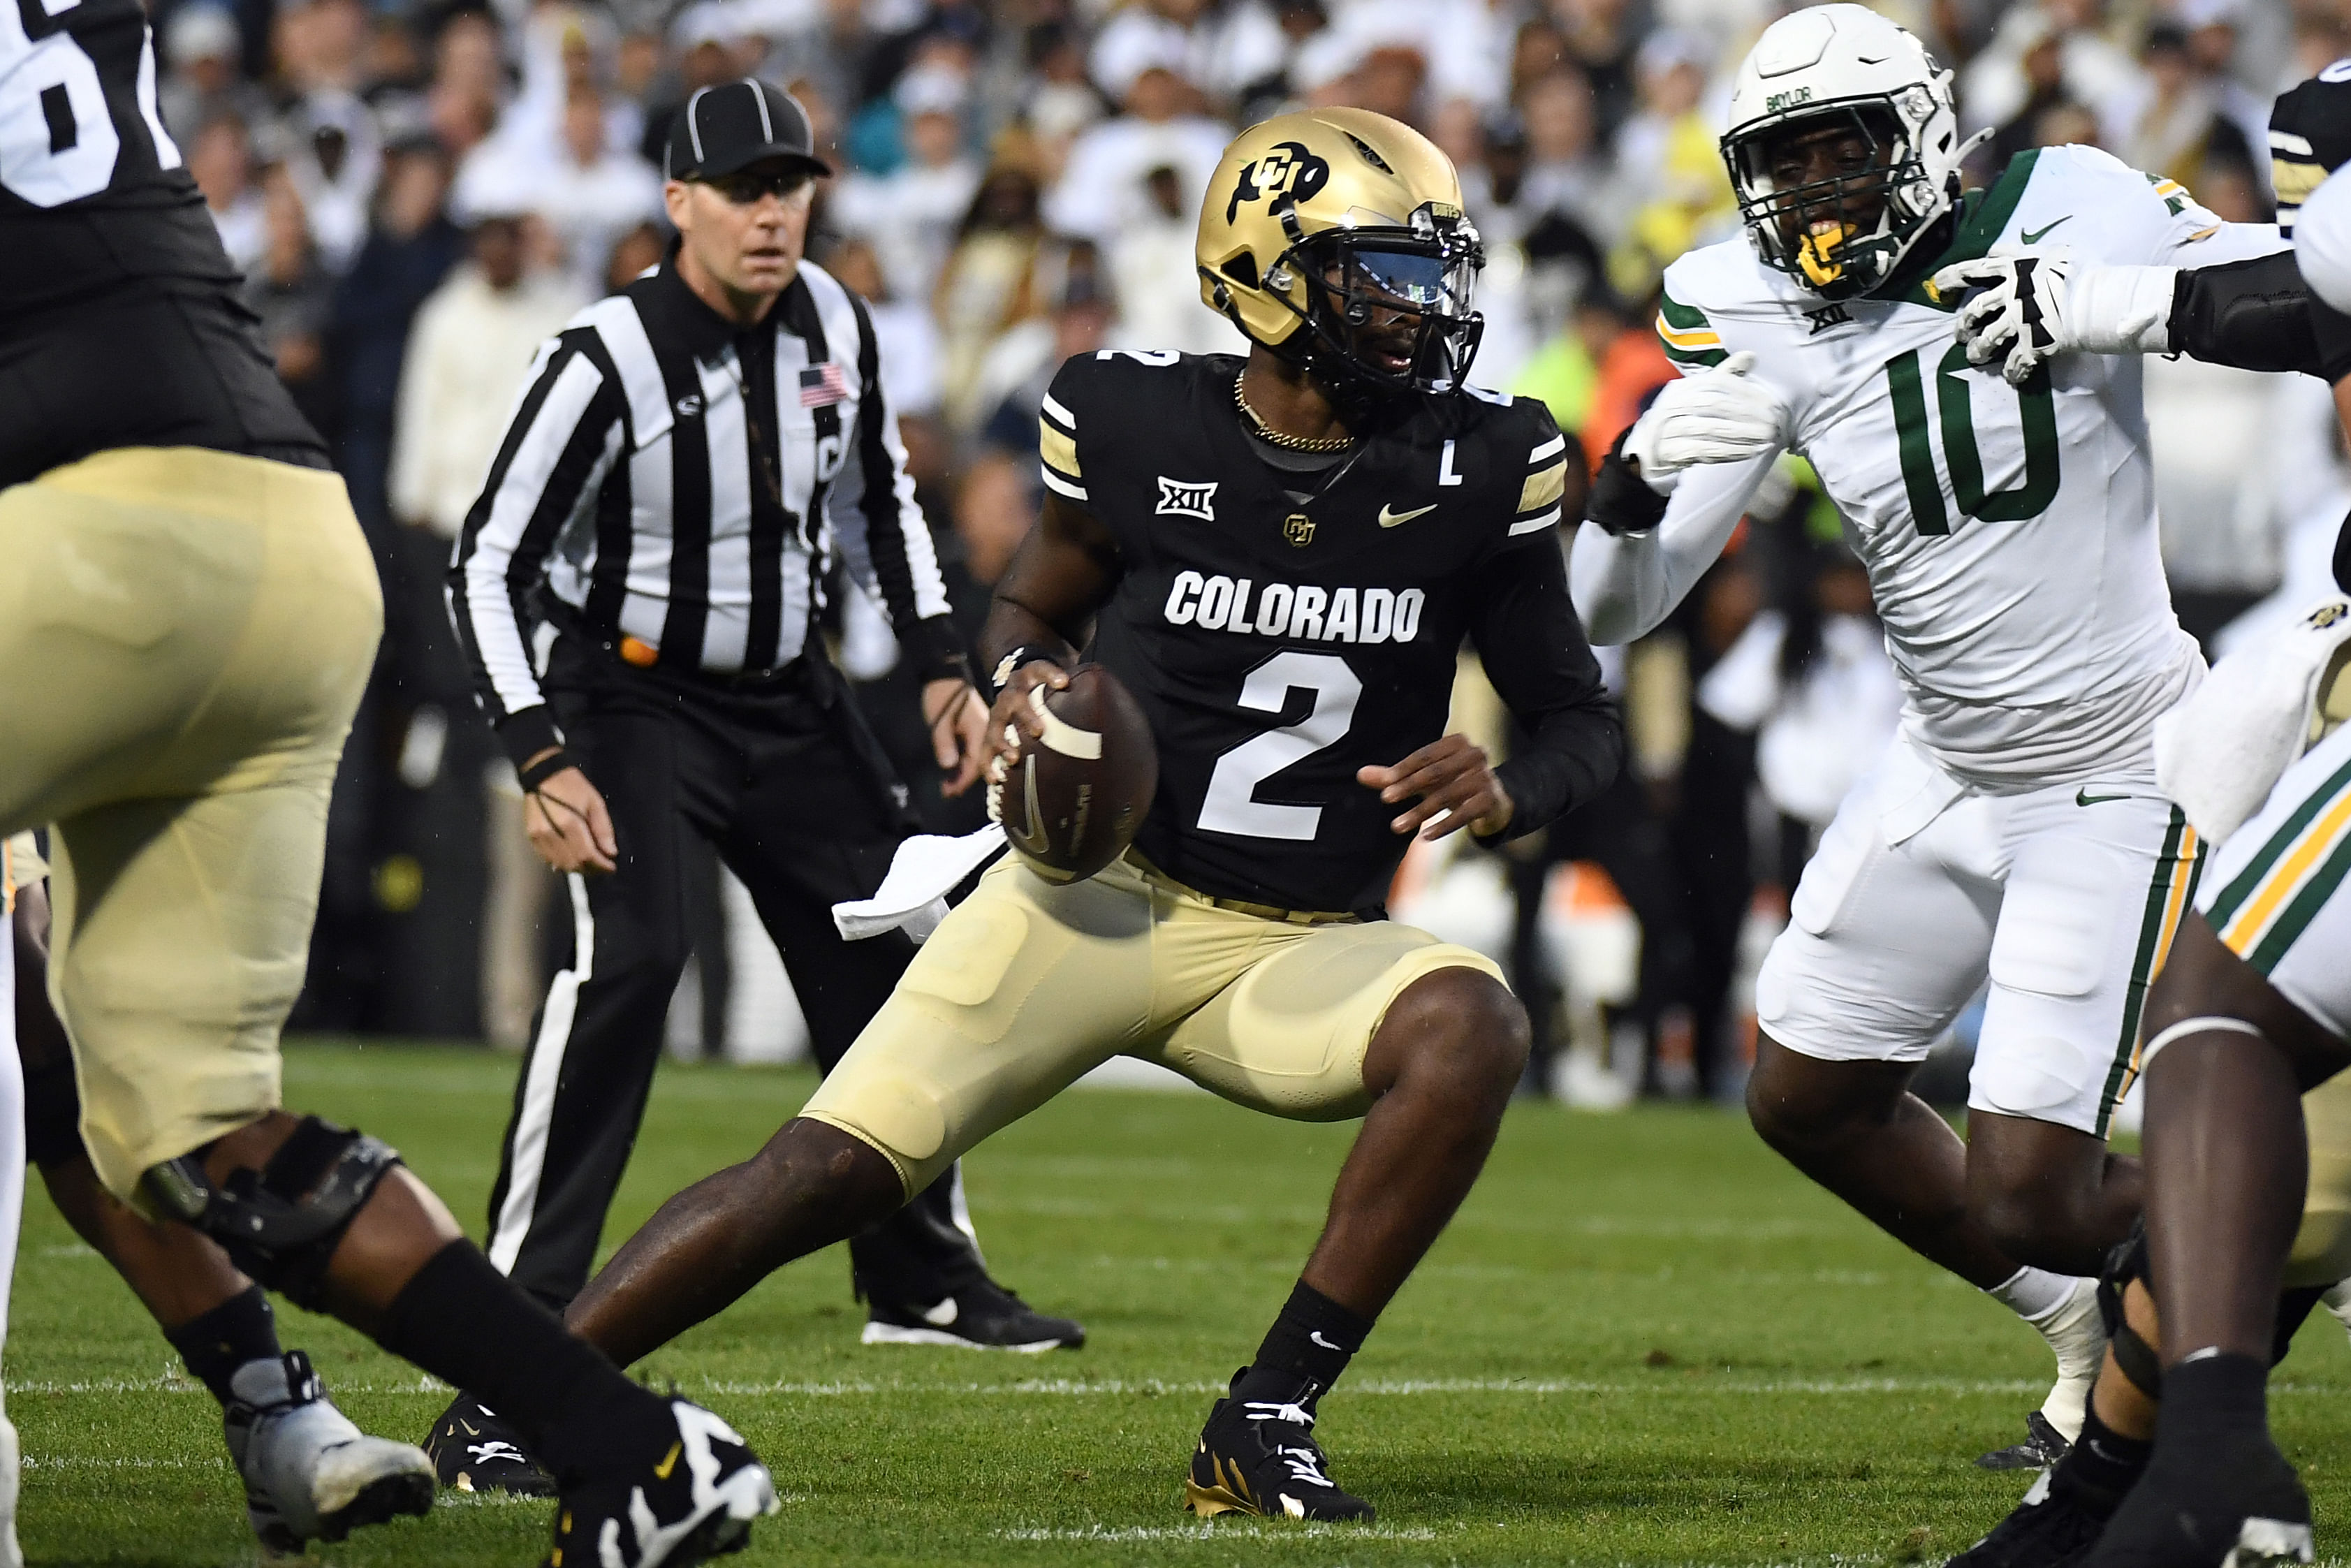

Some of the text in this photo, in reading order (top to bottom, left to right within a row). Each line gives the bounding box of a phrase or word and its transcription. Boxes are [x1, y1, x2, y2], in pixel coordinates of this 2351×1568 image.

[1766, 86, 1812, 114] BAYLOR
[1439, 439, 1463, 486] L
[1884, 342, 2060, 536] 10
[1164, 570, 1426, 644] COLORADO
[1196, 651, 1363, 841] 2
